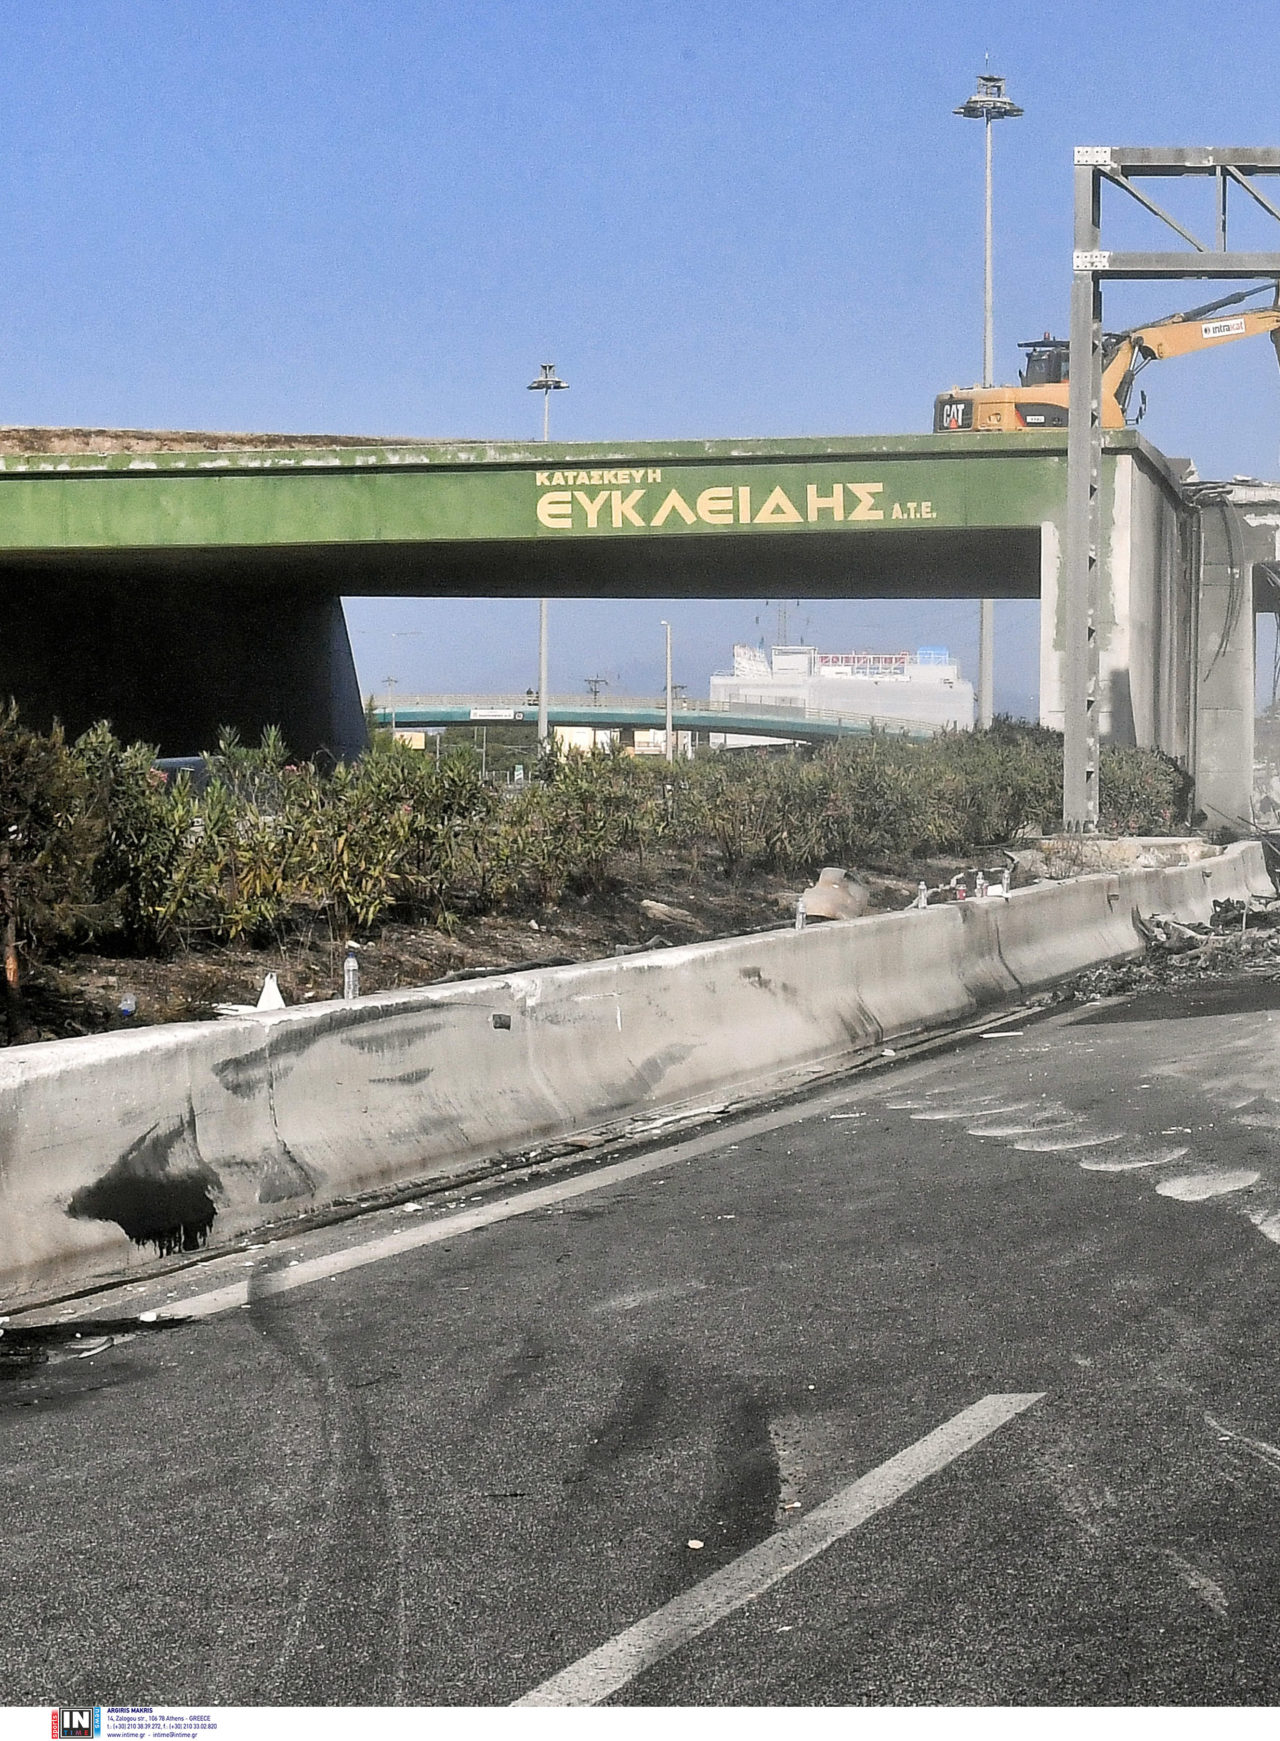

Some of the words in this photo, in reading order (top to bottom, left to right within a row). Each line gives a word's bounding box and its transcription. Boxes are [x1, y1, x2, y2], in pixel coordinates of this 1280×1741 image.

[943, 403, 965, 427] CAT
[536, 469, 662, 486] ΚΑΤΑΣΚΕΥΗ
[536, 482, 884, 528] ΕΥΚΛΕΙΔΗΣ
